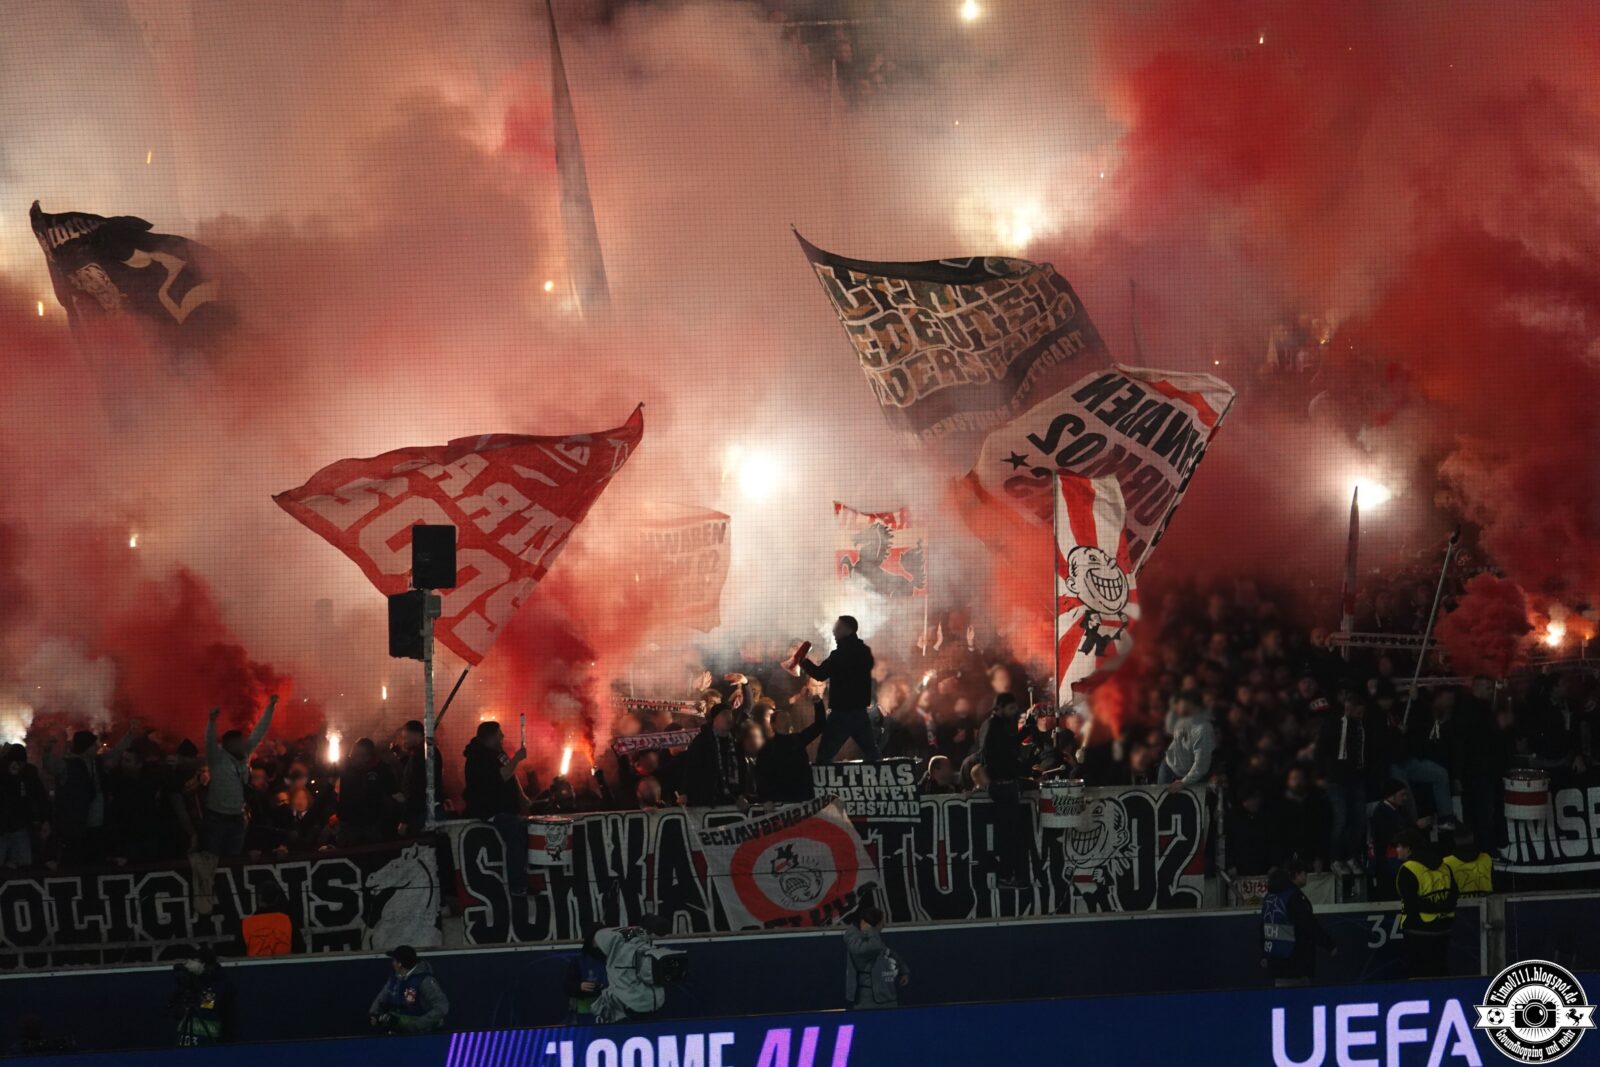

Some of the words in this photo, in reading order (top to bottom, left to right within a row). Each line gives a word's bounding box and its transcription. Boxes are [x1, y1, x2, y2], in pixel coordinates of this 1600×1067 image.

[812, 763, 915, 787] ULTRAS
[846, 800, 920, 817] ERSTAND
[1271, 998, 1483, 1067] UEFA
